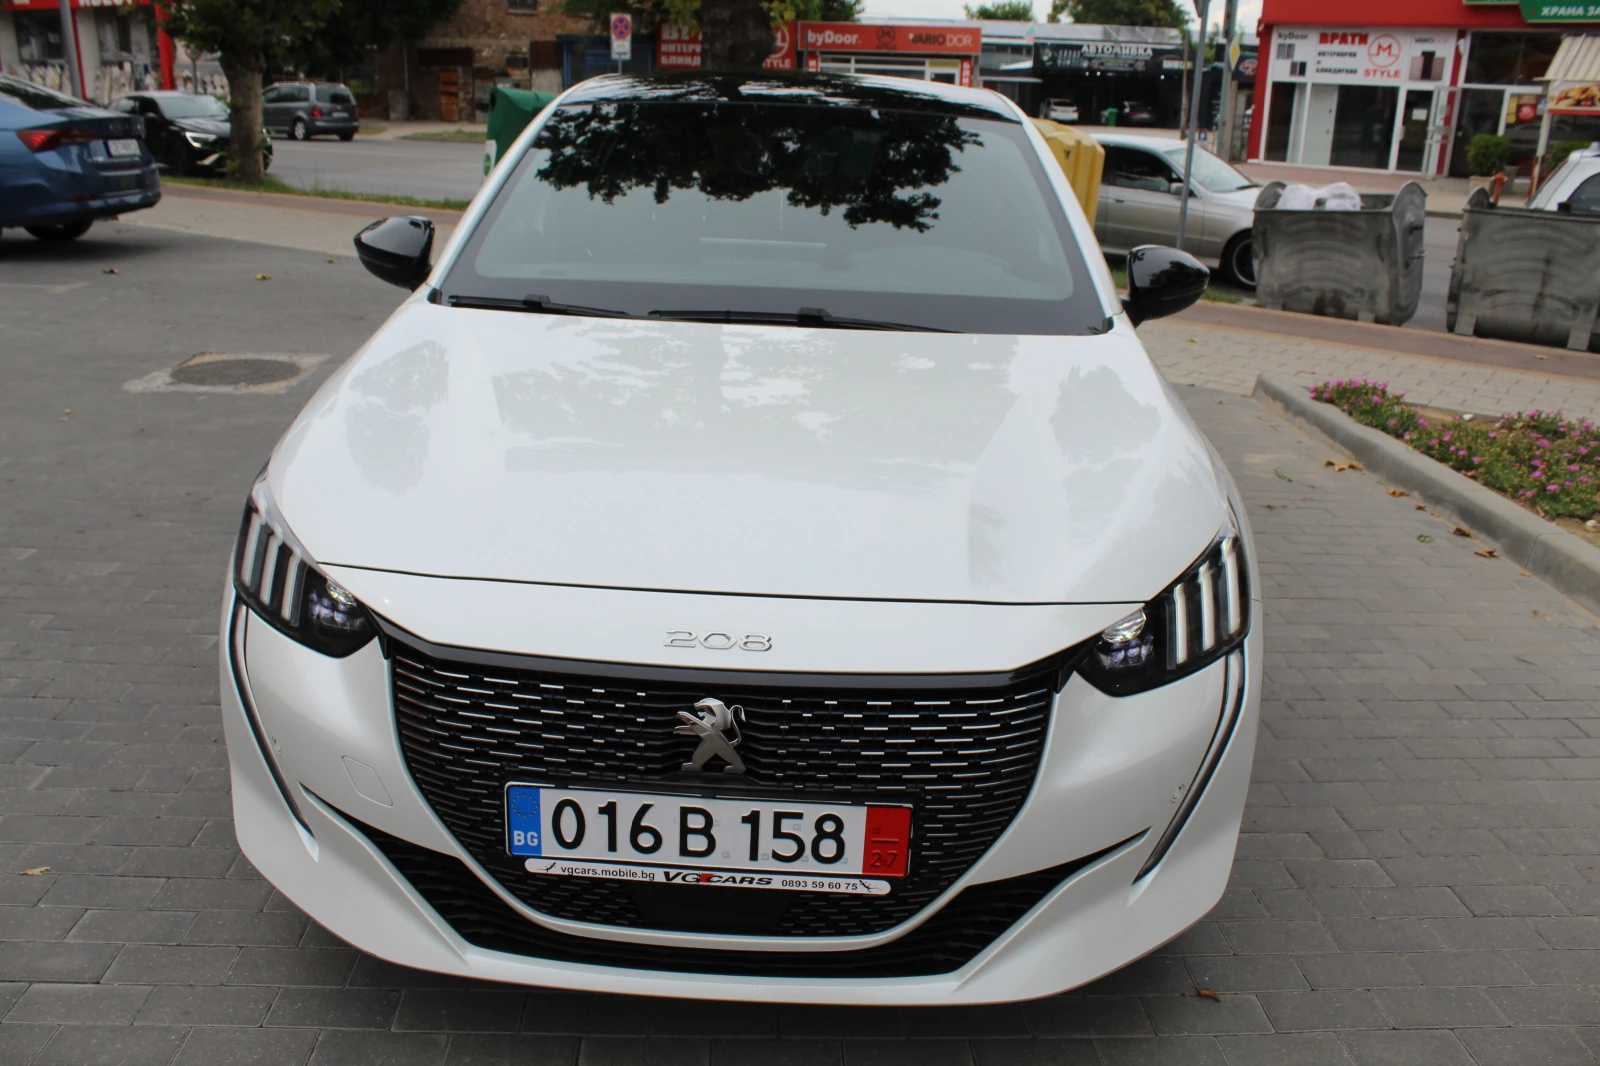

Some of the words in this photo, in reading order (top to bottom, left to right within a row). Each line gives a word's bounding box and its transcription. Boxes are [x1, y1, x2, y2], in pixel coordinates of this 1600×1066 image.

[1541, 6, 1583, 16] ХРАНА
[807, 29, 859, 46] byDoor
[1319, 32, 1369, 46] ВРАТИ
[1081, 43, 1153, 57] АВТОМИВКА
[1364, 69, 1400, 78] STYLE
[663, 629, 772, 651] 208
[513, 830, 539, 847] BG
[552, 797, 663, 855] 016
[741, 809, 846, 865] 158
[870, 850, 899, 868] 27
[560, 865, 656, 881] vgcars.mobile.bg
[781, 878, 808, 888] 0893
[811, 880, 825, 889] 59
[828, 880, 841, 890] 60
[845, 882, 858, 891] 75
